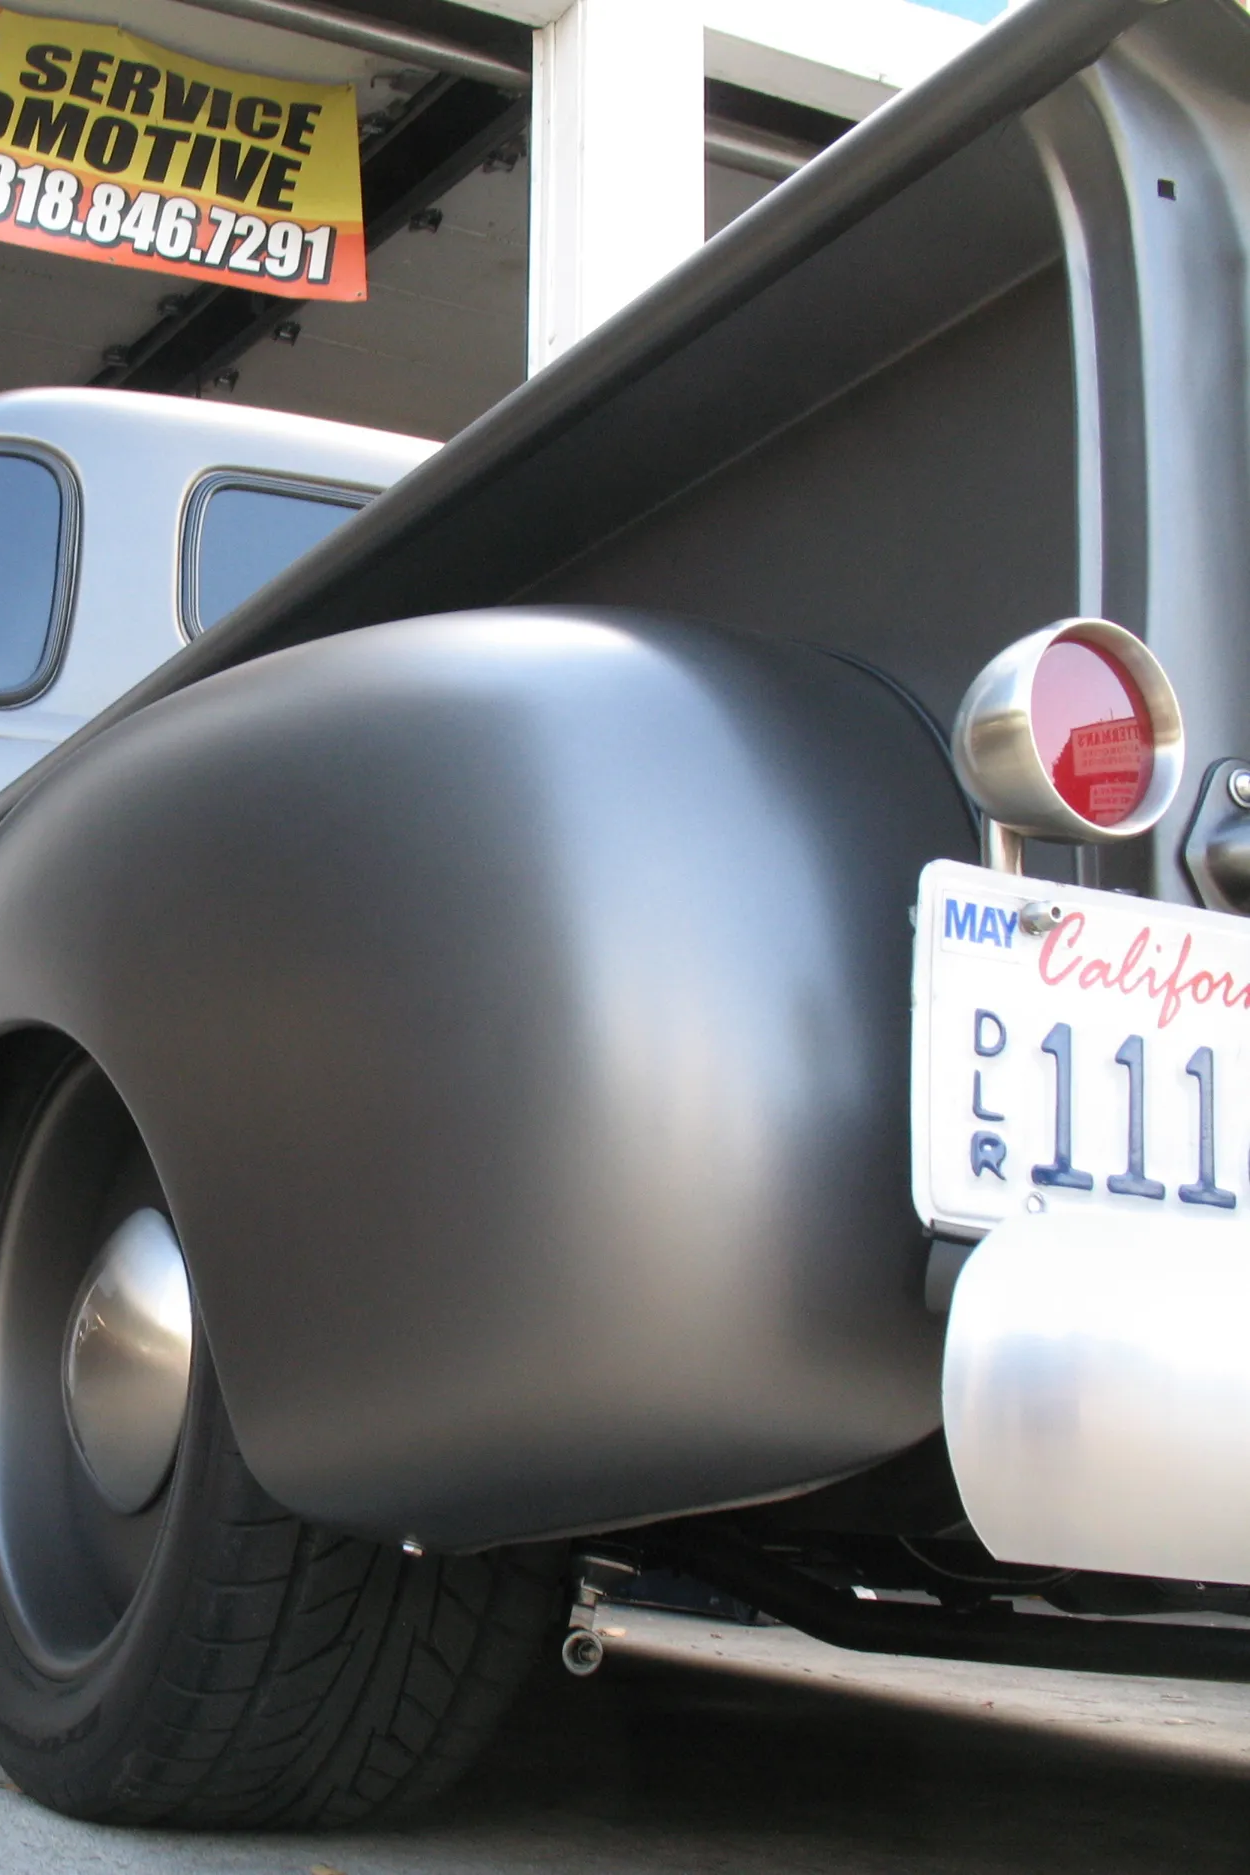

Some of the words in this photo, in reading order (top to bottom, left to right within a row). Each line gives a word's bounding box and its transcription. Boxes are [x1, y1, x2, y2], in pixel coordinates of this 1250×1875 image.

[19, 43, 322, 154] SERVICE
[944, 898, 1018, 949] MAY
[1039, 911, 1250, 1029] Califor
[1031, 1021, 1250, 1209] 111
